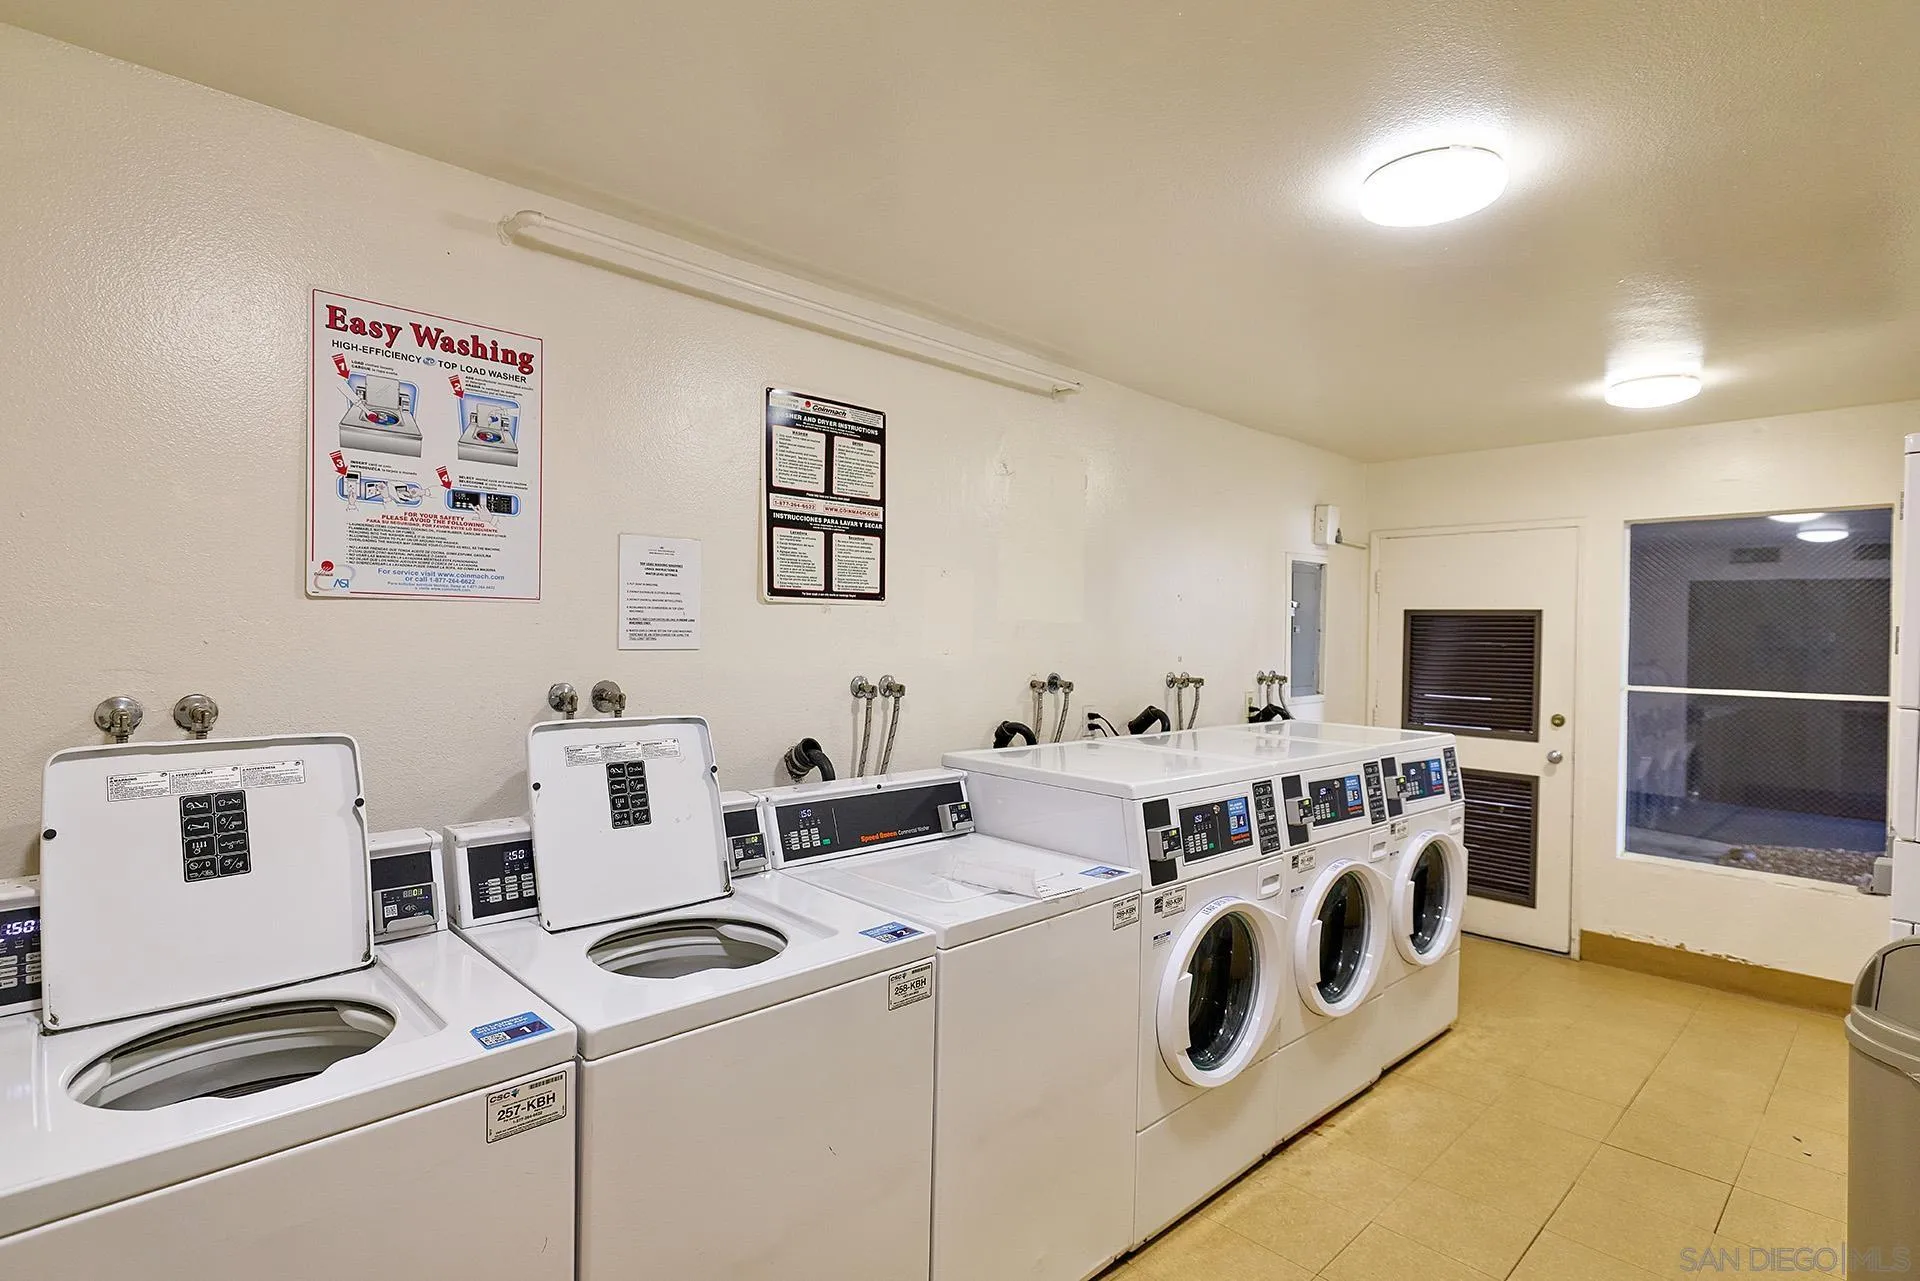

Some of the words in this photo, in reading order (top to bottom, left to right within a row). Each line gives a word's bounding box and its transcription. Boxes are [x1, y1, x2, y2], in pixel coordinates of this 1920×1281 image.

[325, 304, 402, 347] Easy
[410, 322, 534, 375] Washing
[332, 340, 421, 363] HIGH-EFFICIENCY
[438, 360, 457, 369] TOP
[460, 364, 486, 375] LOAD
[488, 370, 526, 383] WASHER
[812, 404, 846, 417] Coinmach
[818, 418, 837, 427] DRYER
[838, 422, 878, 435] INSTRUCTIONS
[773, 512, 822, 523] INSTRUCCIONES
[438, 572, 504, 580] www.coinmach.com
[861, 834, 879, 842] Speed
[894, 978, 926, 995] 258-KBH
[490, 1092, 510, 1103] CSC
[497, 1092, 555, 1121] 257-KBH
